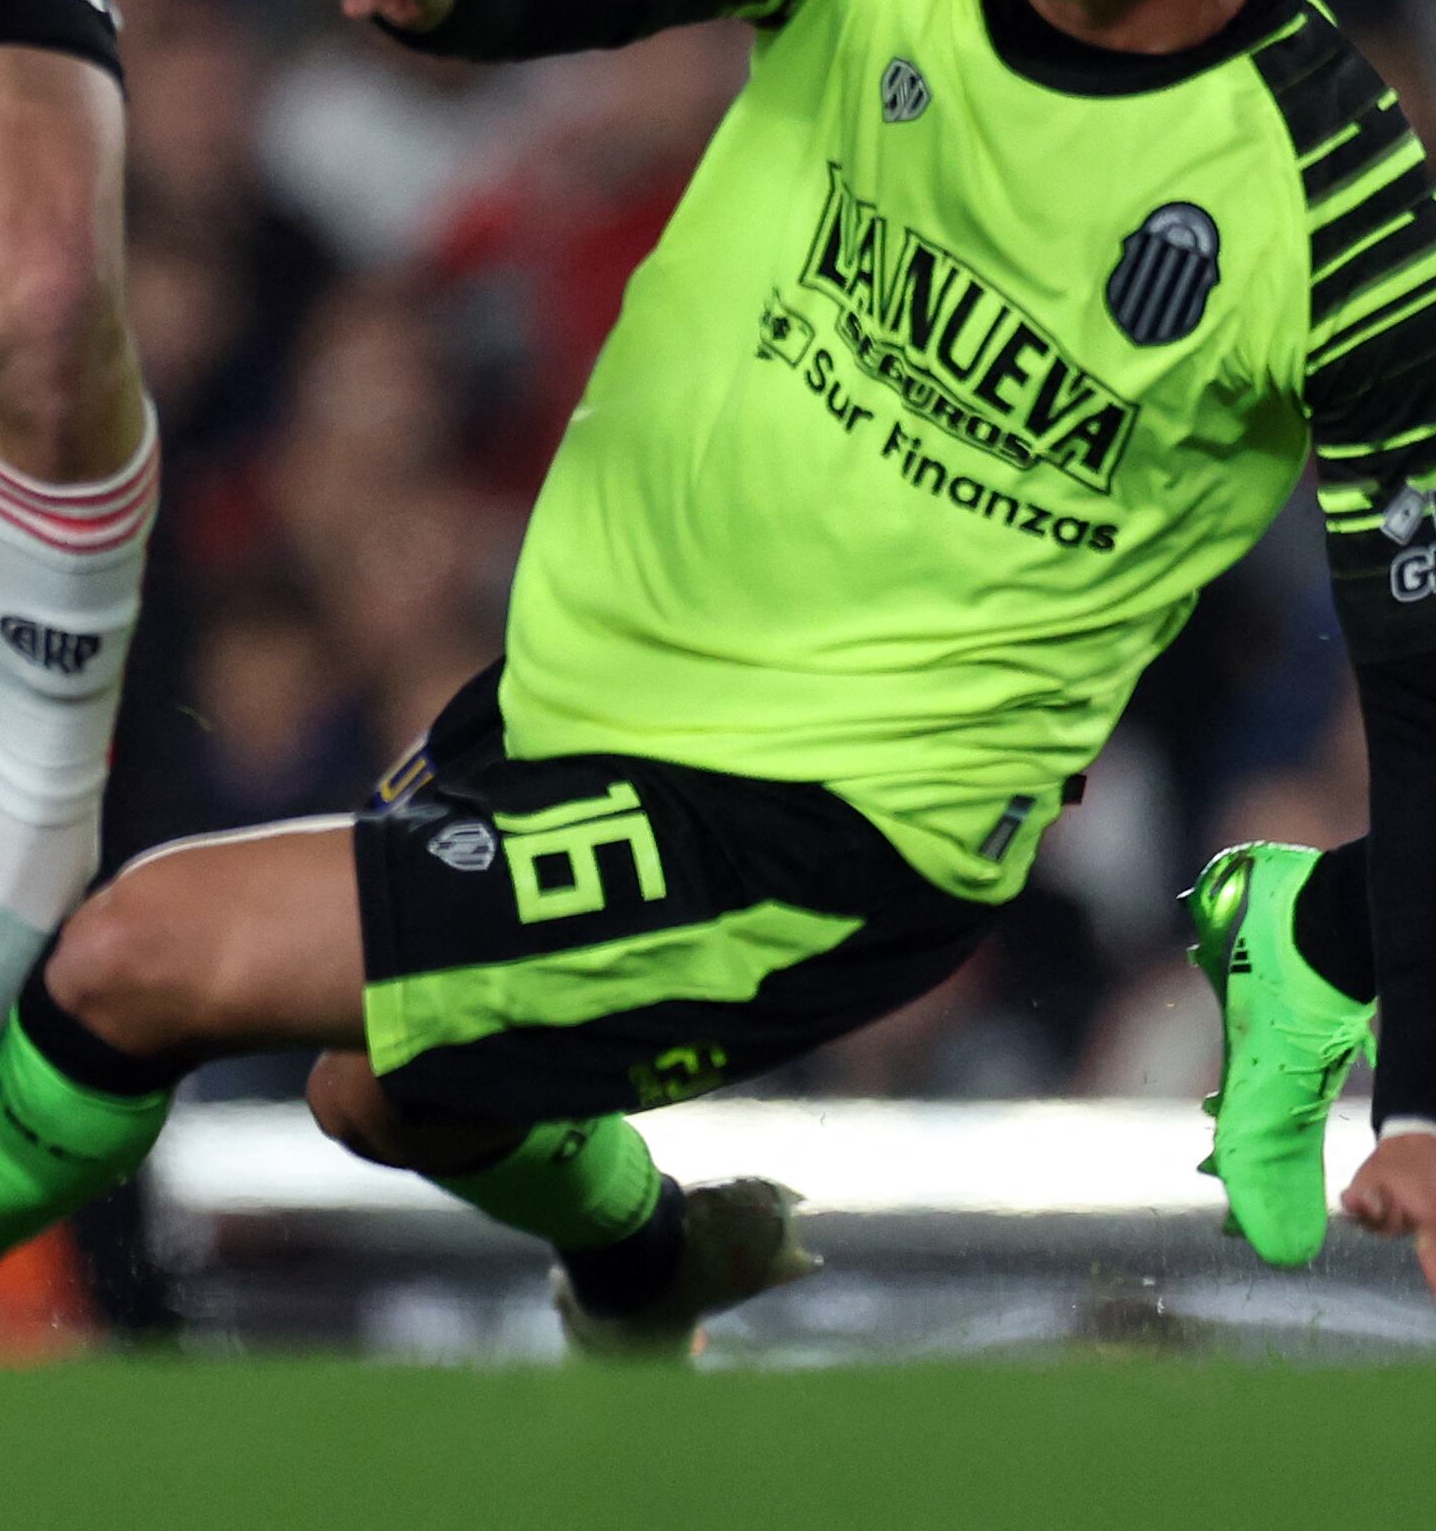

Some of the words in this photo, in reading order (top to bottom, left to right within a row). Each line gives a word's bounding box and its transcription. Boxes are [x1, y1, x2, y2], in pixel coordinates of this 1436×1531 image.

[803, 347, 874, 434] Sur
[881, 421, 1118, 555] Finanzas
[889, 241, 1127, 475] NUEVA
[493, 779, 668, 925] 16
